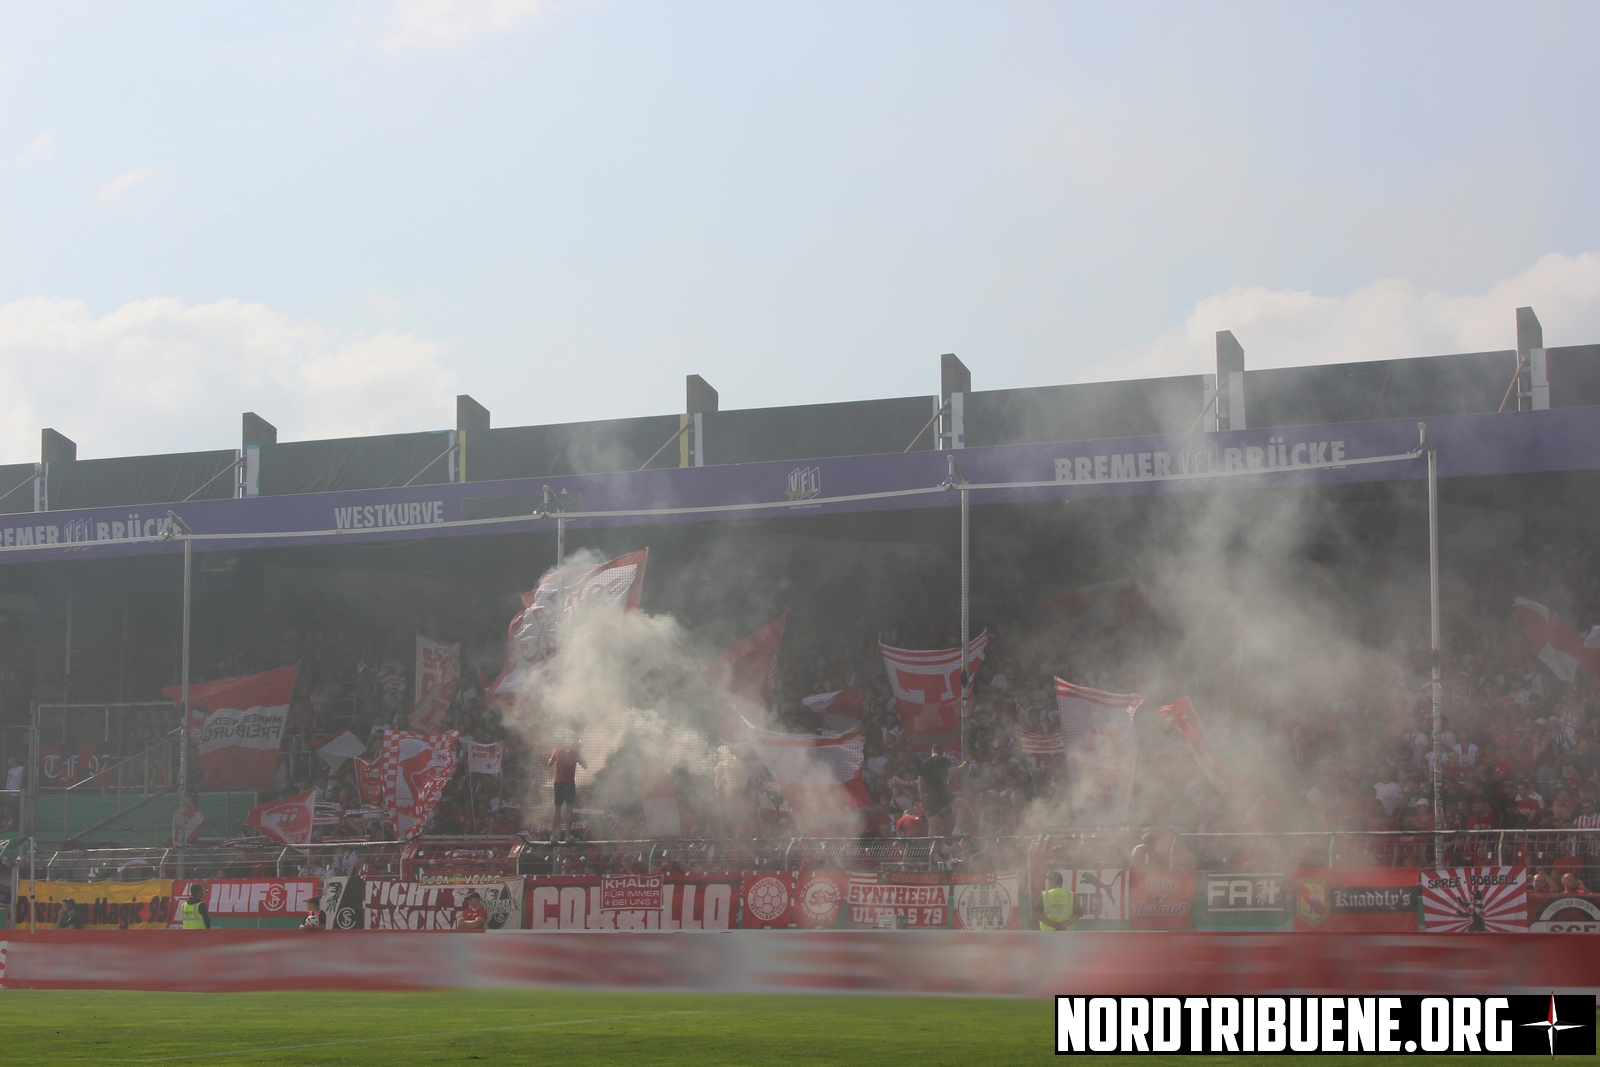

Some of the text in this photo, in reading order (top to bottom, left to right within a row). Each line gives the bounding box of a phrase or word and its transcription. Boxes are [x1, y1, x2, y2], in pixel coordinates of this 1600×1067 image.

[1054, 451, 1172, 482] BREMER
[1224, 437, 1346, 472] BRÜCKE
[789, 468, 820, 498] VFL
[334, 500, 444, 529] WESTKURVE
[0, 525, 60, 548] EMER
[605, 878, 660, 889] KHALID
[1427, 876, 1462, 889] SPREE
[1469, 874, 1518, 886] BOBBELE
[365, 880, 446, 907] FIGHT
[604, 889, 660, 899] FÜR IMMER
[612, 898, 628, 906] BEI
[849, 885, 946, 905] SYNTHESIA
[1333, 888, 1412, 909] Knaddly's
[93, 895, 145, 929] Magic
[147, 895, 170, 924] 95
[924, 908, 943, 925] 79
[1584, 903, 1595, 912] DEN
